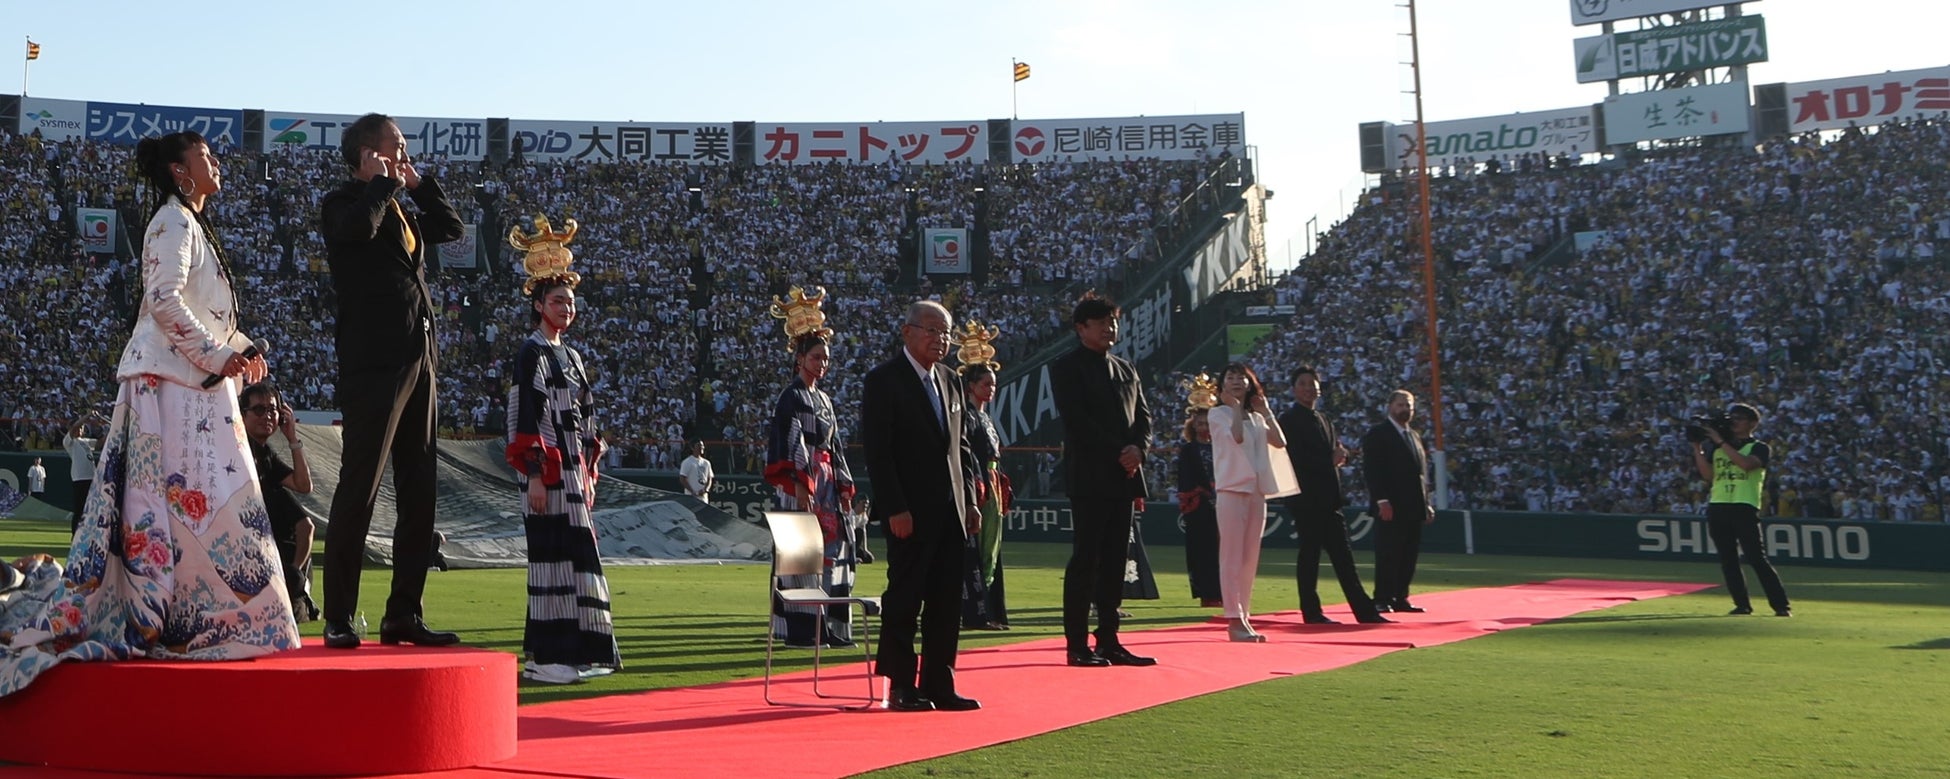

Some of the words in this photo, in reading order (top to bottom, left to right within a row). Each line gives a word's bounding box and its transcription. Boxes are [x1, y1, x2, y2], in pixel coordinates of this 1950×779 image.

[1644, 96, 1704, 128] 生茶
[1792, 78, 1950, 125] オロナミ
[40, 119, 81, 129] sysmex
[90, 110, 235, 145] シスメックス
[1053, 122, 1241, 153] 尼崎信用金庫
[1540, 116, 1590, 132] 大和工業
[1541, 130, 1591, 147] グループ
[576, 126, 731, 161] 大同工業
[765, 126, 980, 161] カニトップ
[1183, 211, 1249, 312] YKK
[1725, 484, 1737, 493] 17
[1637, 520, 1871, 560] SHIANO
